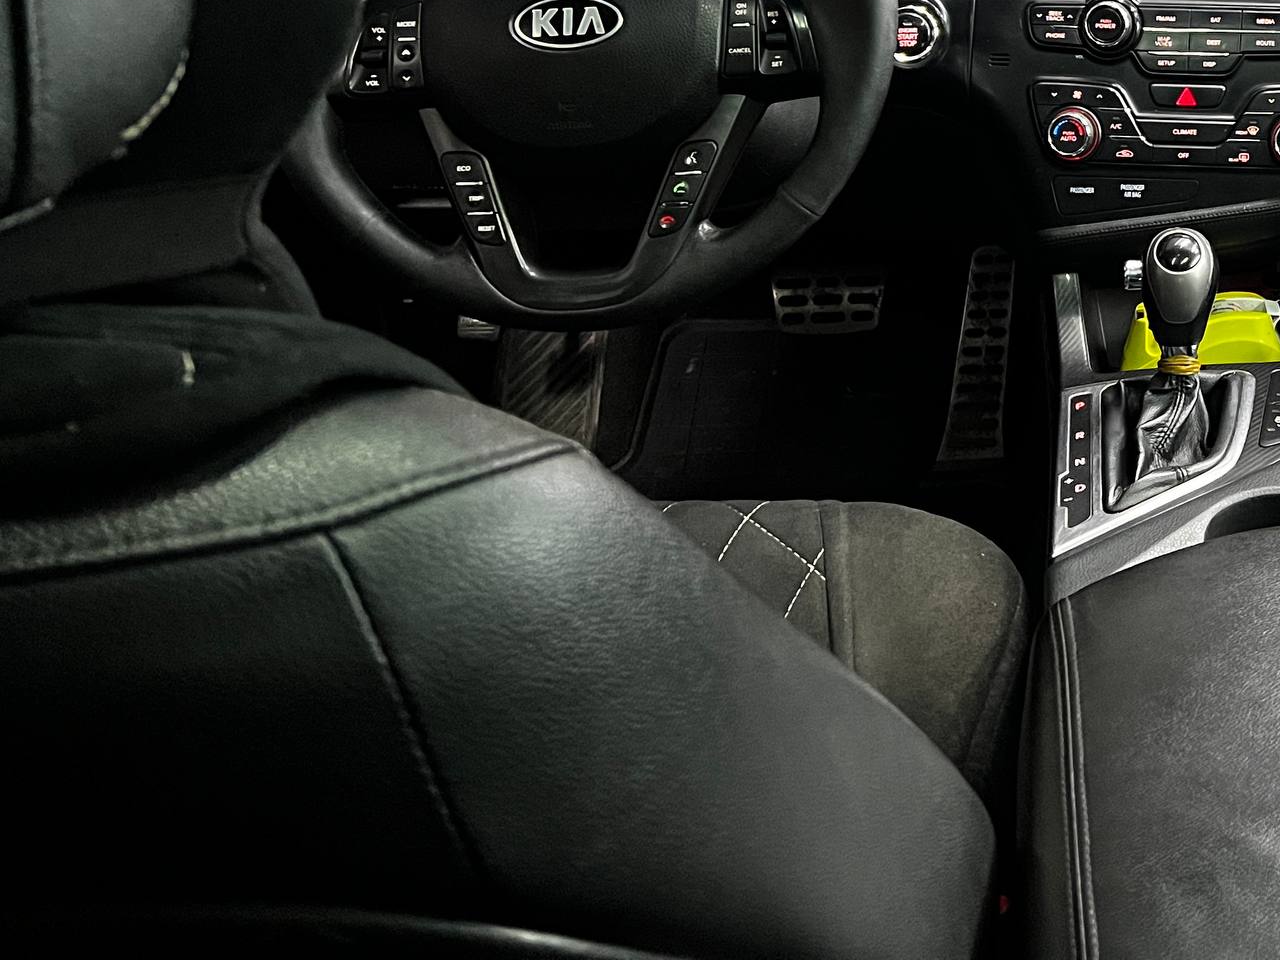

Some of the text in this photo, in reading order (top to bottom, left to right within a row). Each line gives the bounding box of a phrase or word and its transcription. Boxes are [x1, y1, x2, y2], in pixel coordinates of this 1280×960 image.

[531, 6, 606, 38] KIA
[728, 47, 752, 55] CANCEL
[771, 60, 784, 68] SET
[1157, 59, 1176, 67] SETUP
[1172, 128, 1198, 136] CLIMATE
[1074, 401, 1086, 411] P
[1074, 431, 1086, 440] R
[1074, 457, 1087, 467] N
[1074, 483, 1087, 493] D
